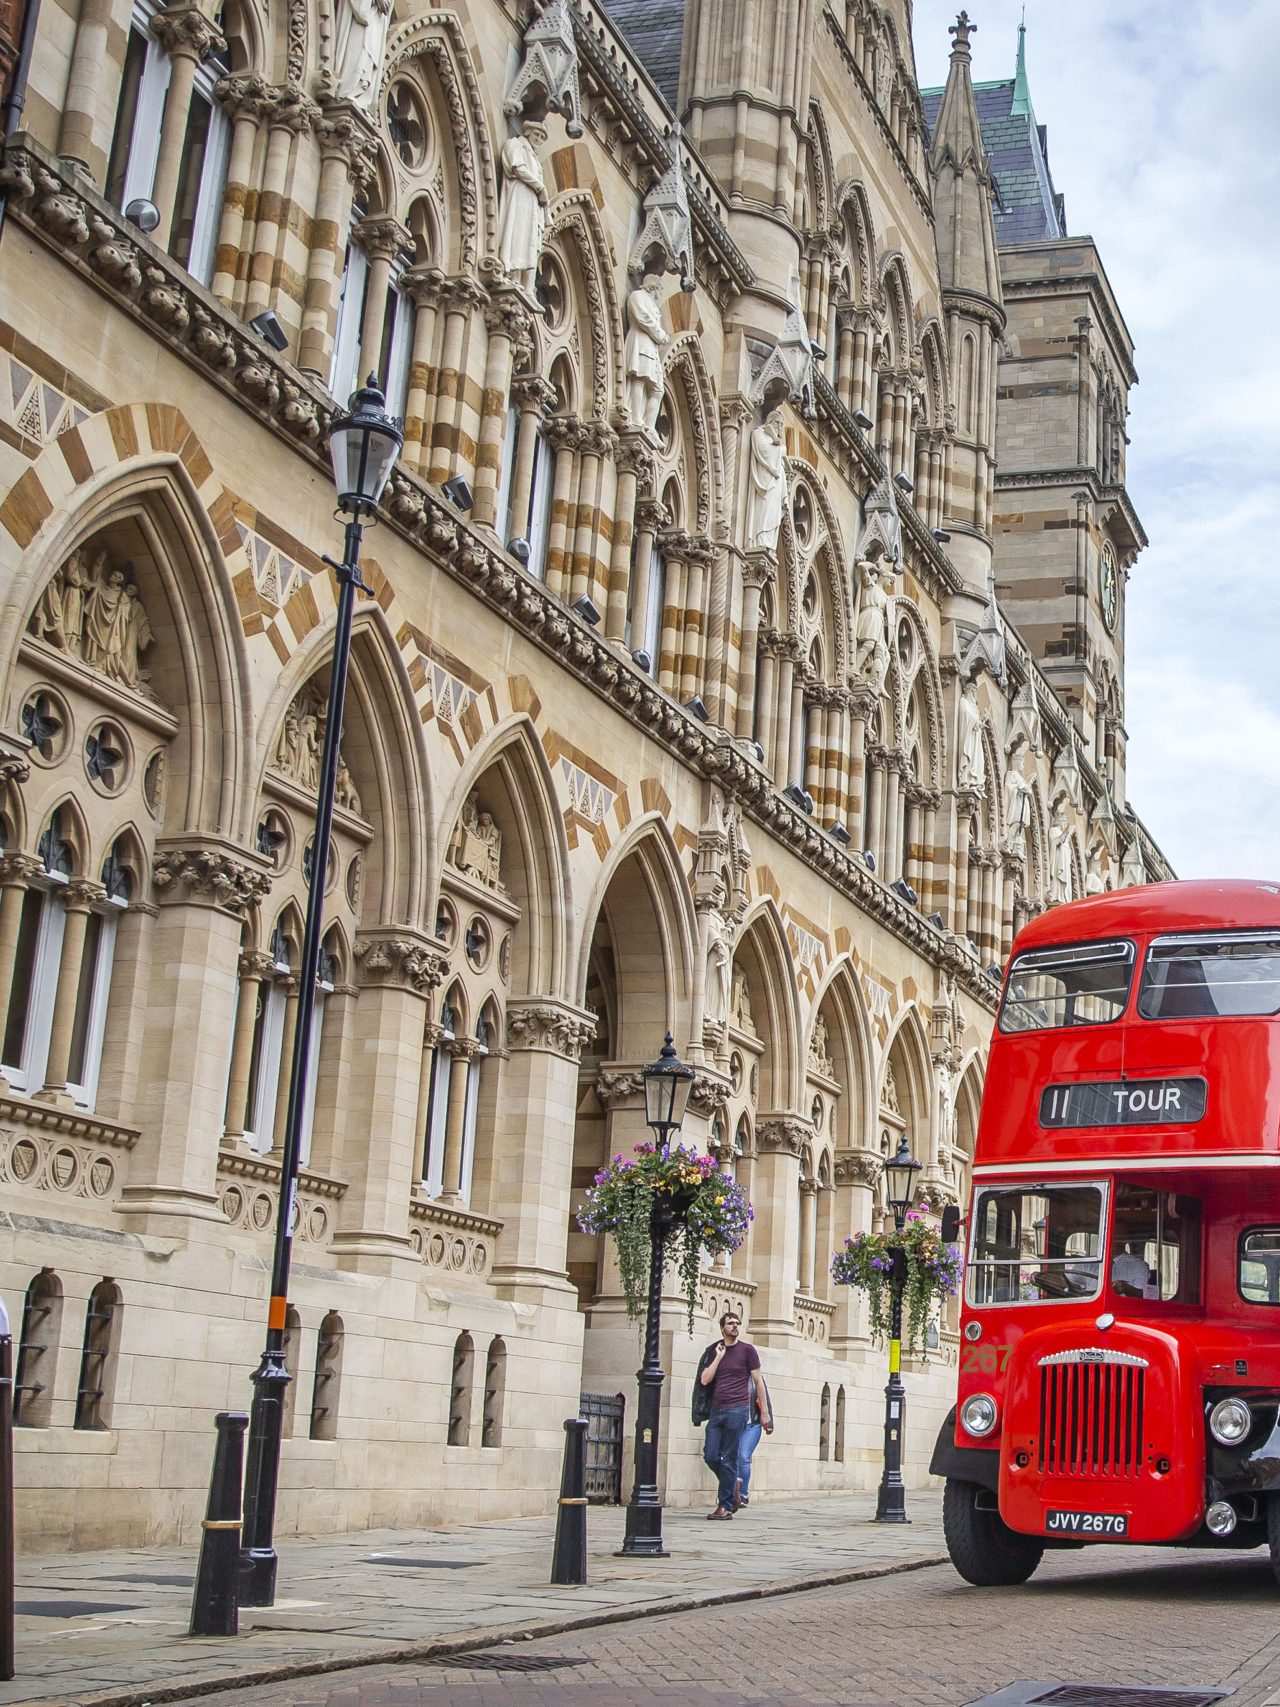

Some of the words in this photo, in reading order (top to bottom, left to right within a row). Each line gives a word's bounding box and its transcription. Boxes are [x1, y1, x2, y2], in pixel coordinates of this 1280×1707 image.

[1113, 1087, 1182, 1113] TOUR
[962, 1344, 1014, 1373] 267
[1048, 1512, 1080, 1530] JVV
[1082, 1514, 1125, 1533] 267G
